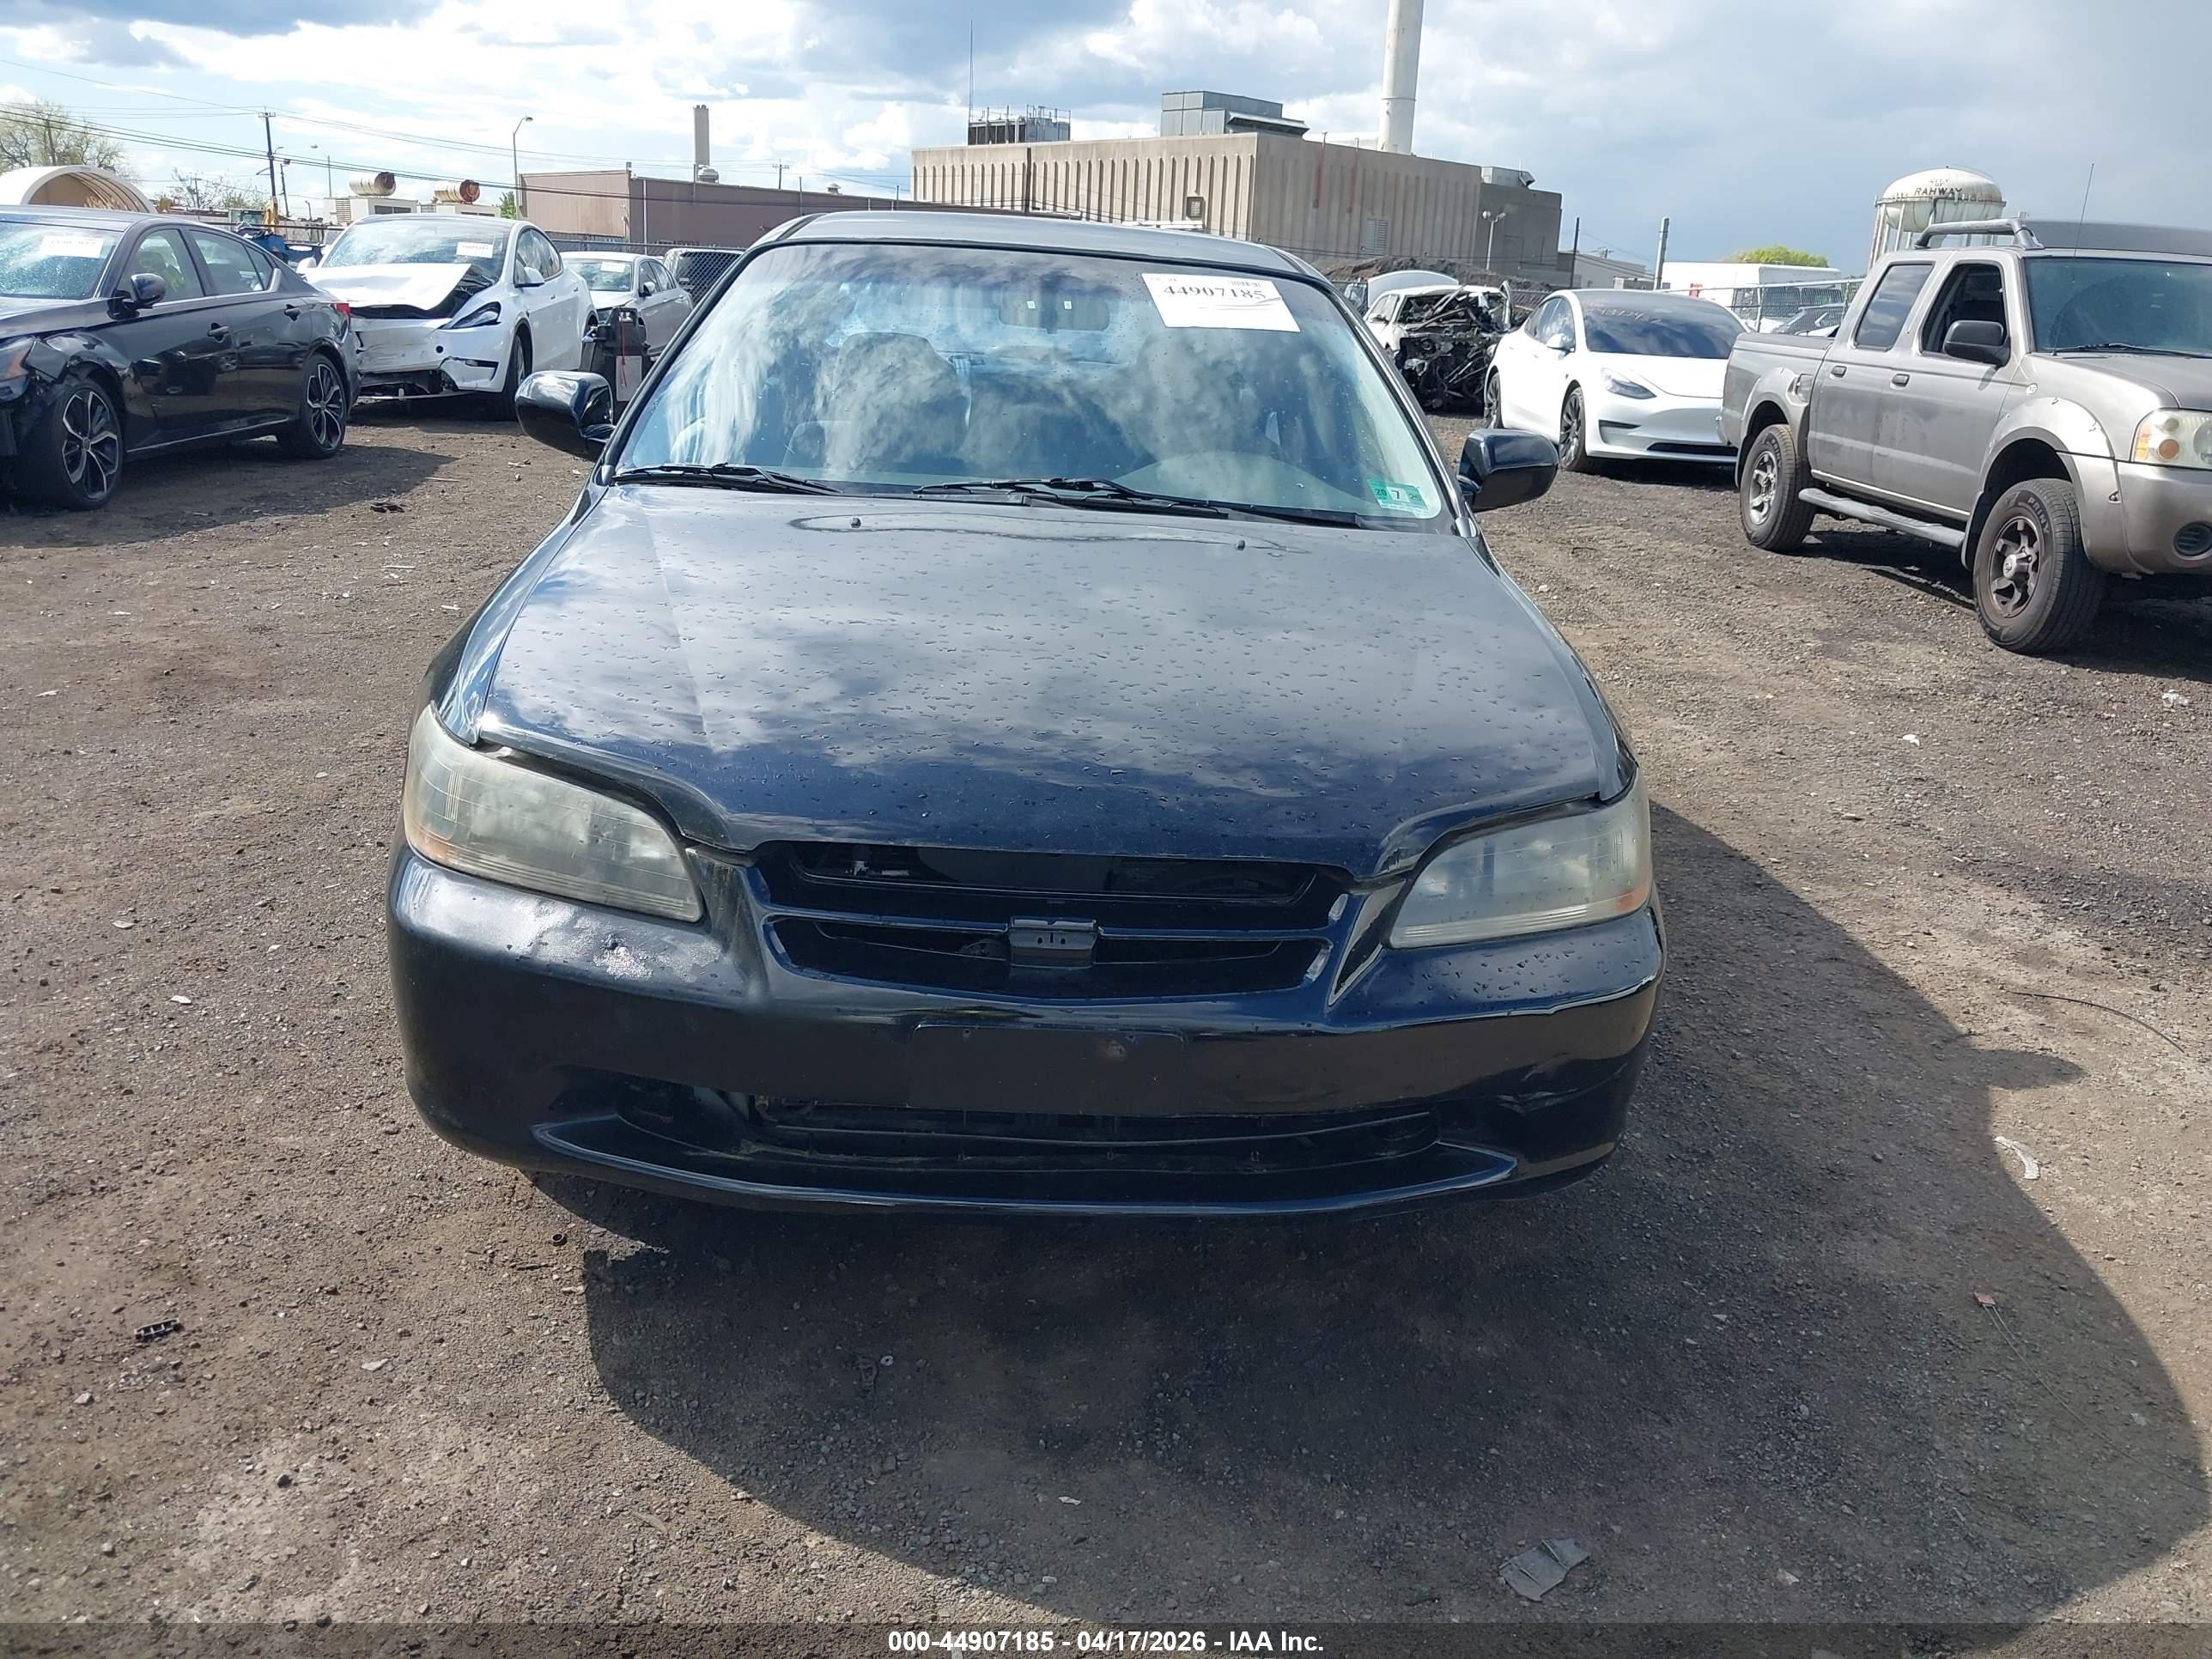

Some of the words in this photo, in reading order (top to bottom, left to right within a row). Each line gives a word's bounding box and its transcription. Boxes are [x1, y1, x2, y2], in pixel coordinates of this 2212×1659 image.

[1914, 187, 1962, 196] RAHWAY
[1163, 285, 1267, 300] 44907185
[1391, 489, 1400, 500] 7
